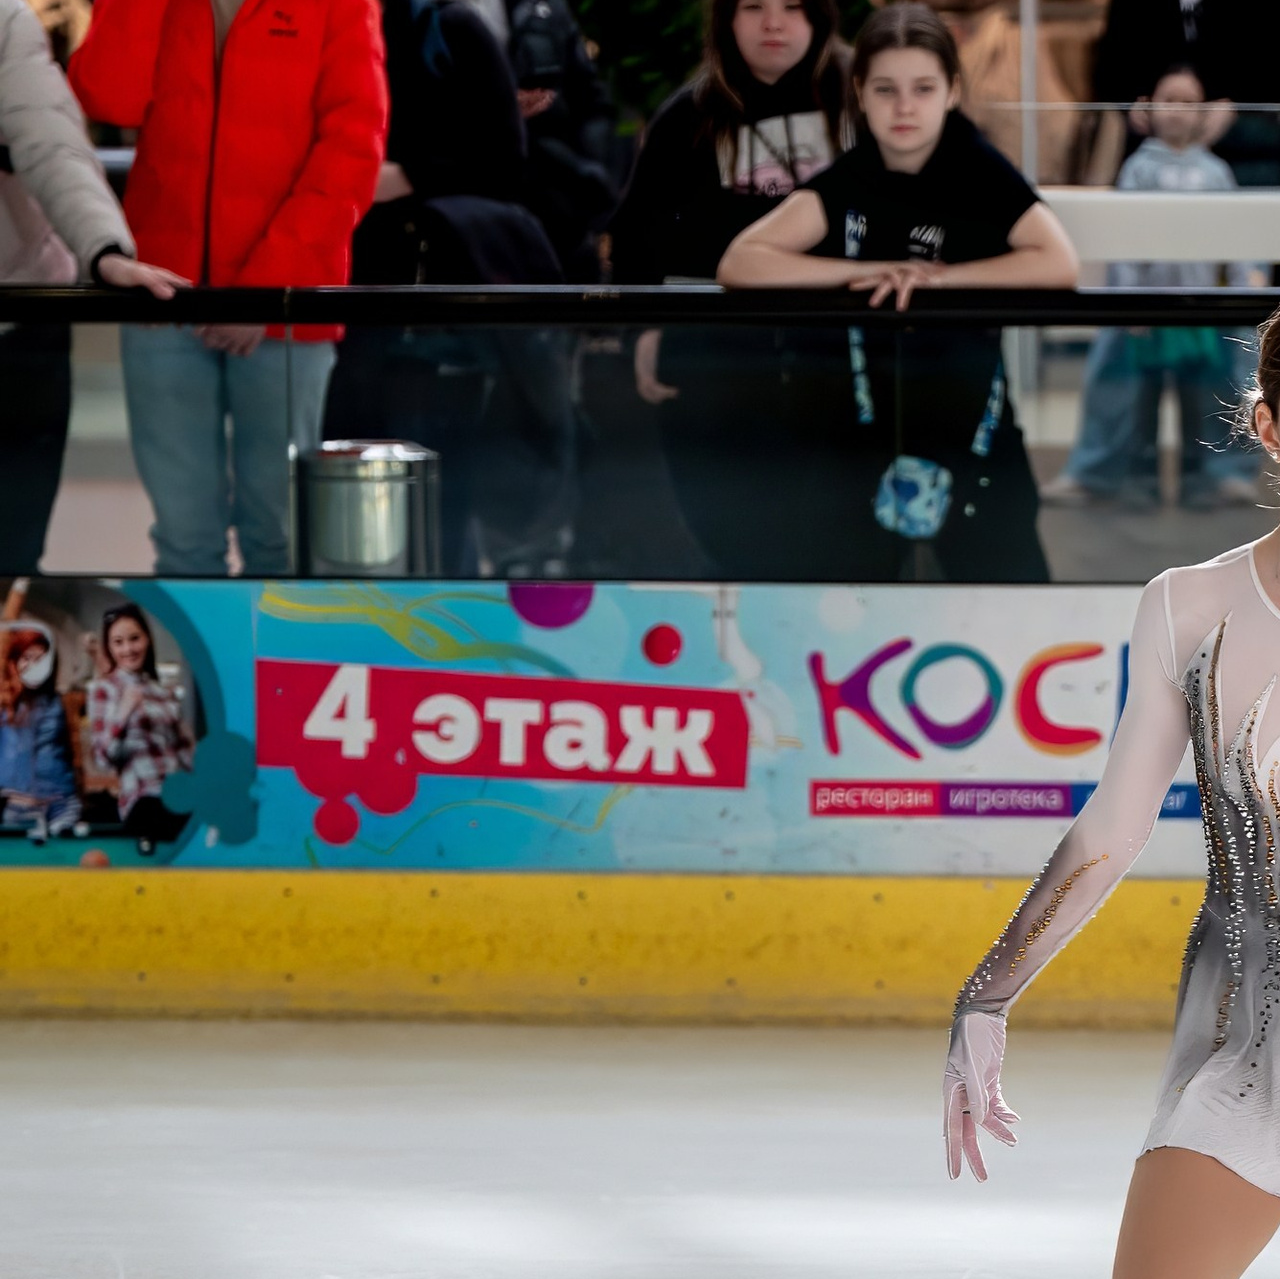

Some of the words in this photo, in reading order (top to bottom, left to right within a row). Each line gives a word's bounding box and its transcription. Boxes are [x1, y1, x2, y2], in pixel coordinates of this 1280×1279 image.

[303, 663, 376, 759] 4
[412, 692, 716, 778] этаж
[815, 786, 933, 813] ресторан
[949, 787, 1064, 814] игротека
